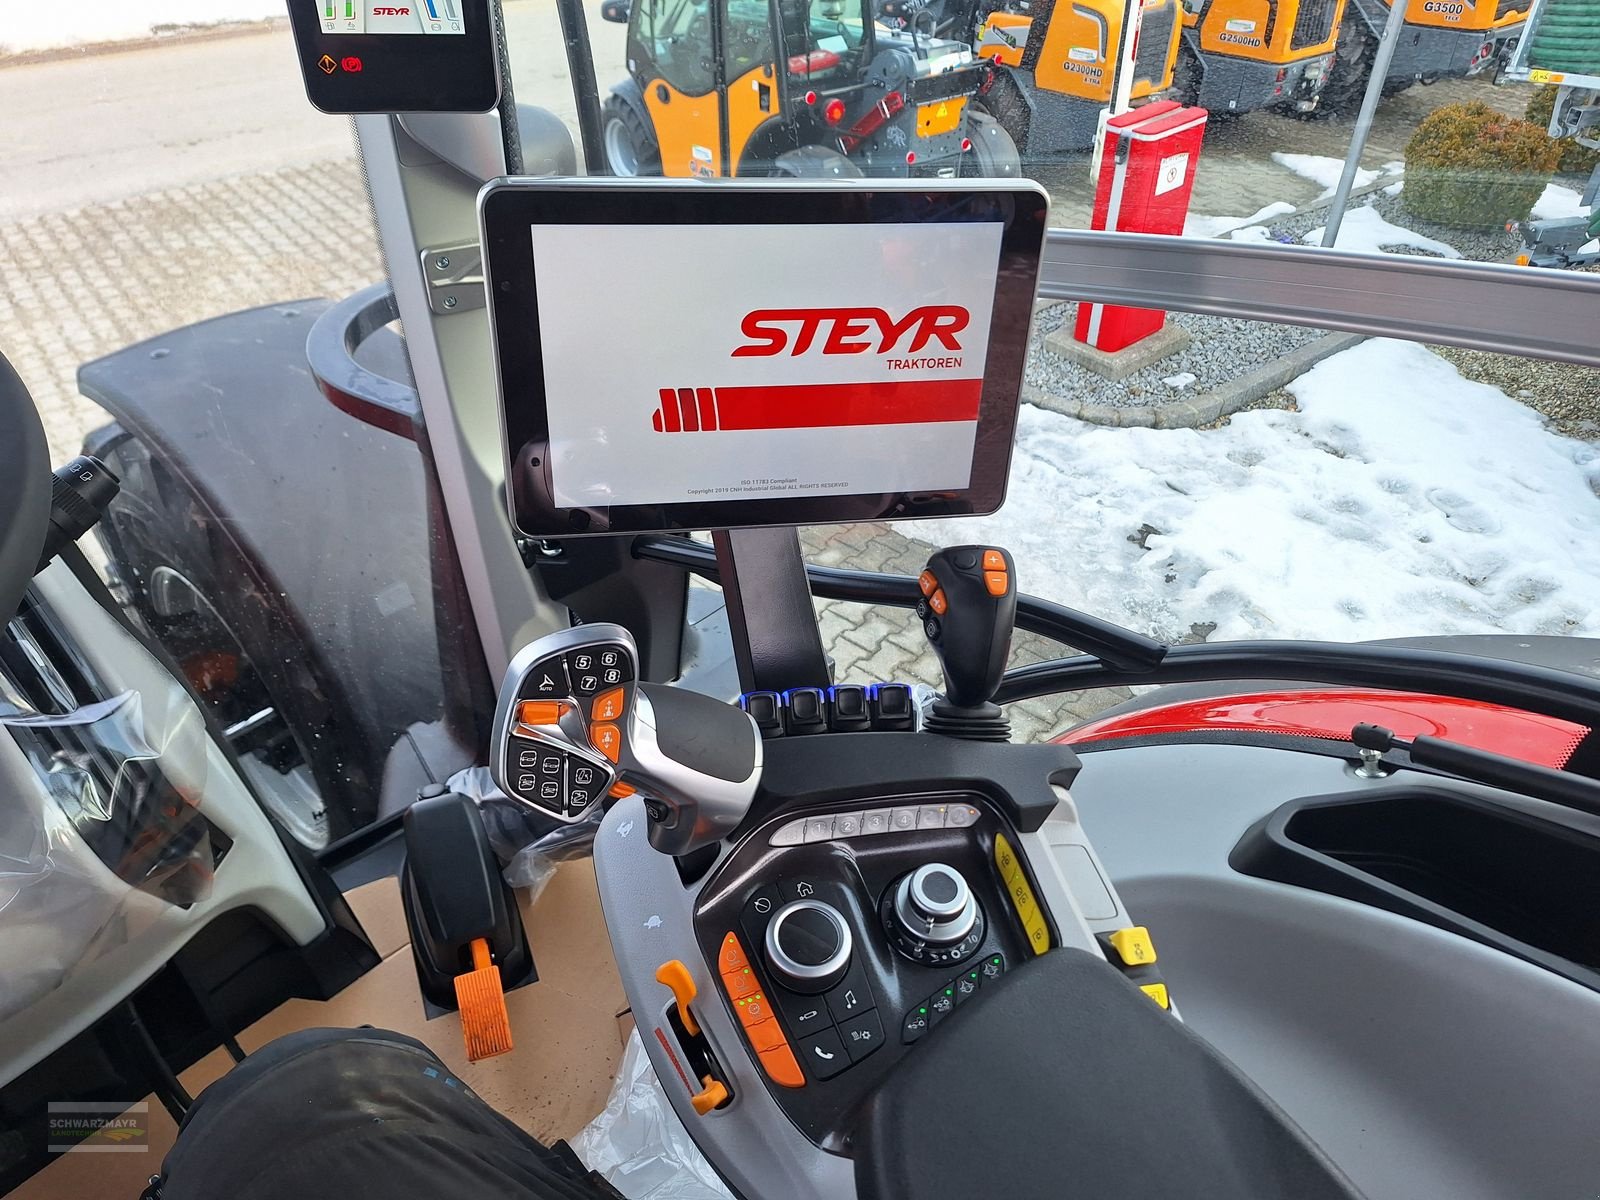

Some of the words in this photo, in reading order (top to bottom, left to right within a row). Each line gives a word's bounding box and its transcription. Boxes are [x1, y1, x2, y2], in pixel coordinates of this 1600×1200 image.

[373, 8, 410, 16] STEYR
[1424, 1, 1464, 14] G3500
[1219, 32, 1261, 47] G2500HD
[1063, 61, 1103, 78] G2300HD
[731, 305, 970, 357] STEYR
[886, 357, 963, 370] TRAKTOREN
[579, 657, 588, 667] 5
[605, 654, 613, 664] 6
[586, 678, 594, 688] 7
[608, 671, 617, 681] 8
[968, 934, 978, 944] 10
